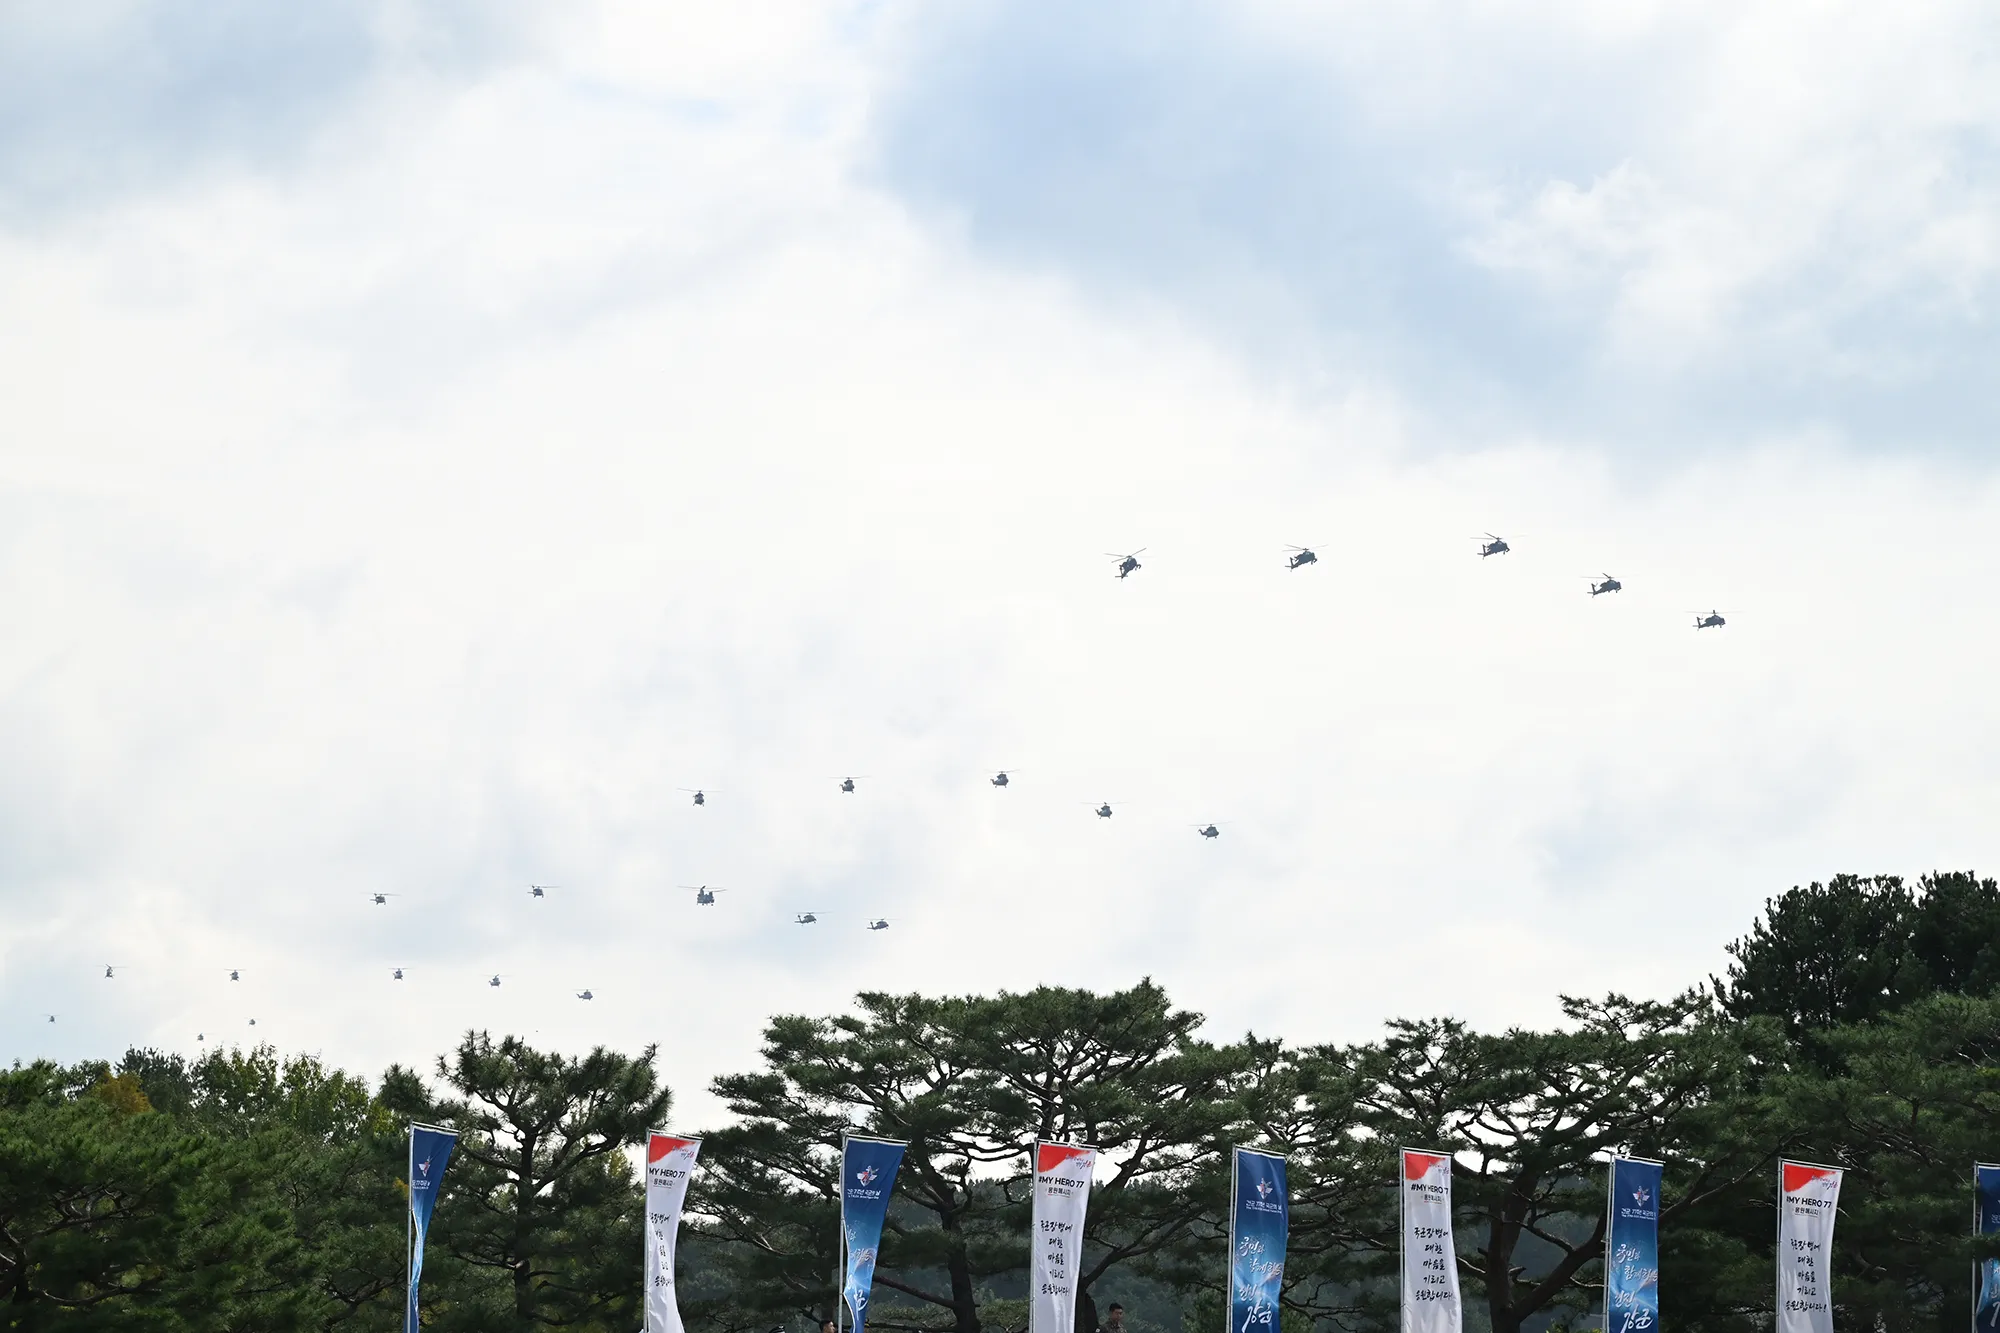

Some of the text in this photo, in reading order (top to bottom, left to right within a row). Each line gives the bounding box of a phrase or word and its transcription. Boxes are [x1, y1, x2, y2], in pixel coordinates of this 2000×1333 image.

[660, 1169, 678, 1178] HERO
[1055, 1177, 1075, 1187] HERO
[1801, 1198, 1822, 1207] HERO
[1041, 1220, 1073, 1232] 국군장병에
[1048, 1237, 1063, 1249] 대한
[1240, 1237, 1265, 1257] 국민과
[1425, 1243, 1442, 1254] 대한
[1048, 1252, 1064, 1266] 마음을
[1616, 1244, 1640, 1263] 국민과
[1423, 1258, 1446, 1270] 마음을
[1798, 1255, 1814, 1267] 대한
[1798, 1270, 1816, 1283] 마음을
[1786, 1300, 1827, 1313] 응원합니다!
[1242, 1299, 1273, 1333] 강군
[1620, 1304, 1653, 1333] 강군
